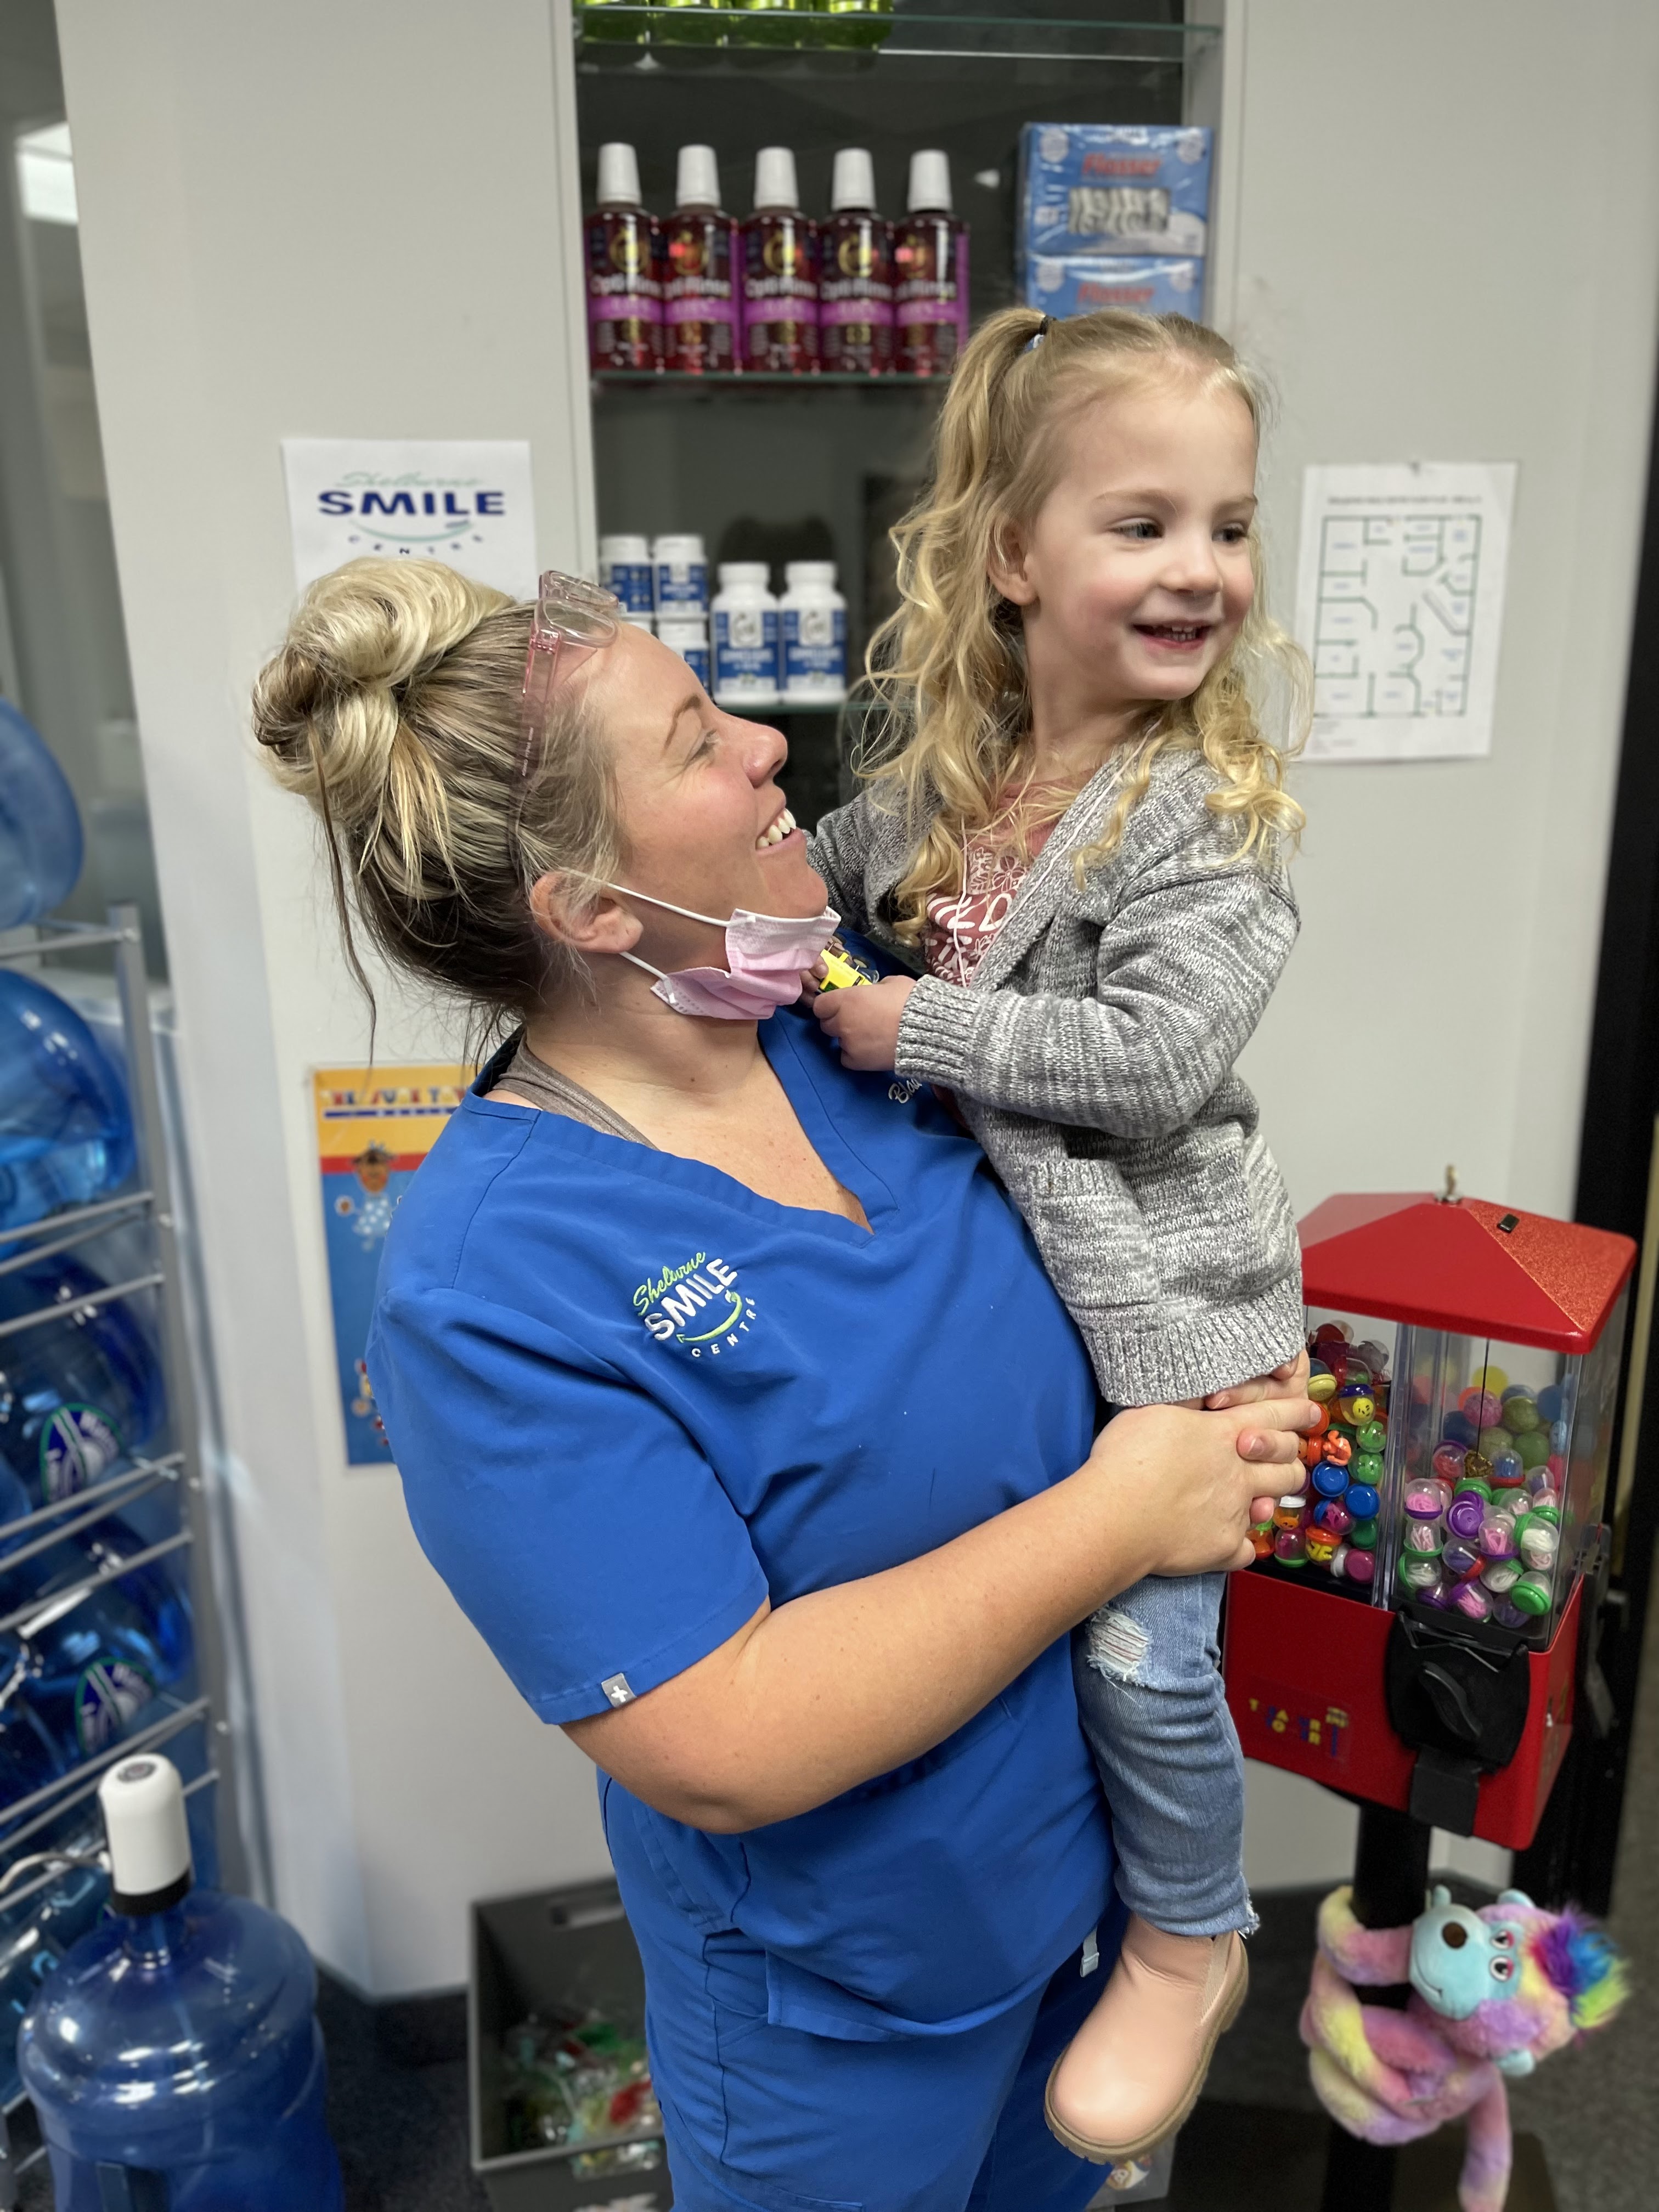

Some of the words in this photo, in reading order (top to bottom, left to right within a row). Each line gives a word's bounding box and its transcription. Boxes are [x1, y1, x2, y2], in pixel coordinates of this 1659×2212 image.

[318, 490, 505, 516] SMILE
[644, 1258, 738, 1341] SMILE
[691, 1296, 757, 1358] CENTRE
